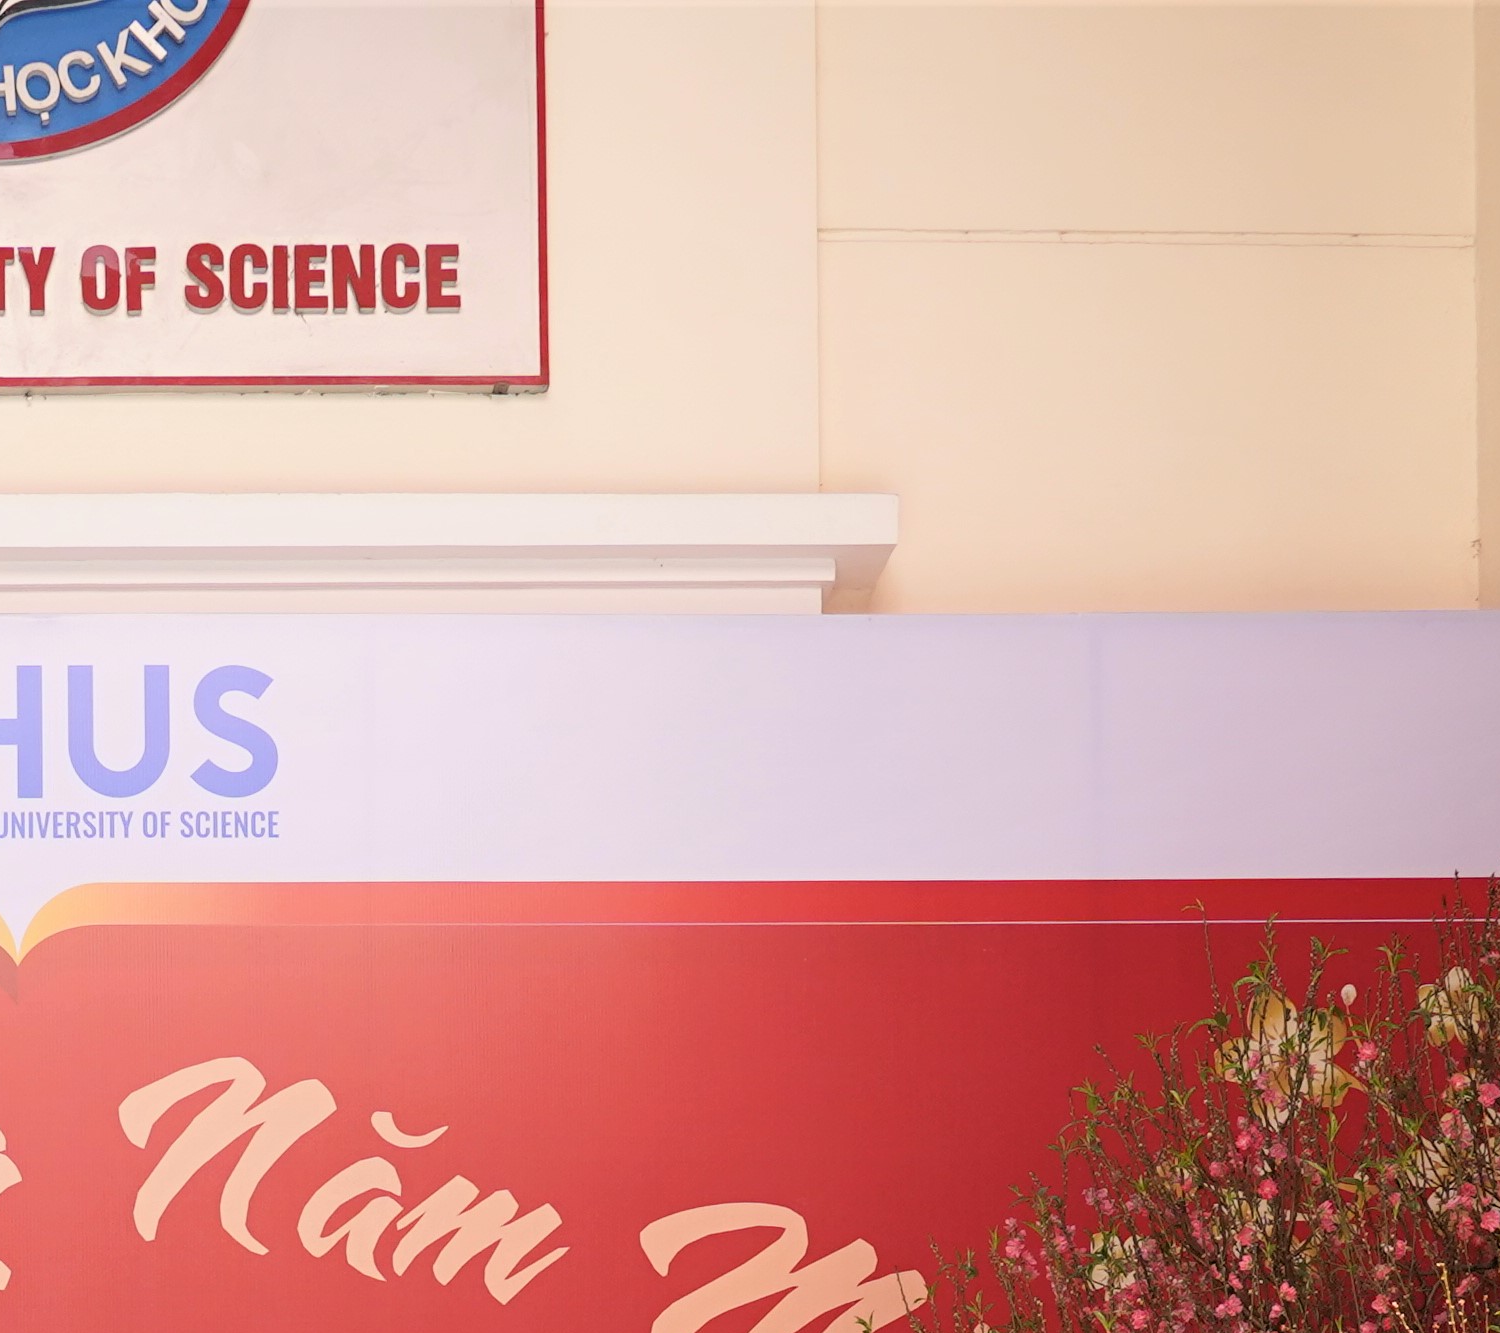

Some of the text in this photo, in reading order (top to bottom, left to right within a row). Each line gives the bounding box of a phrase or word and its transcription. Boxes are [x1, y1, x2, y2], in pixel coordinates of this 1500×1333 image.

[81, 244, 156, 316] OF
[183, 243, 463, 314] SCIENCE
[142, 811, 171, 839] OF
[179, 811, 279, 839] SCIENCE
[118, 1056, 571, 1306] Năm
